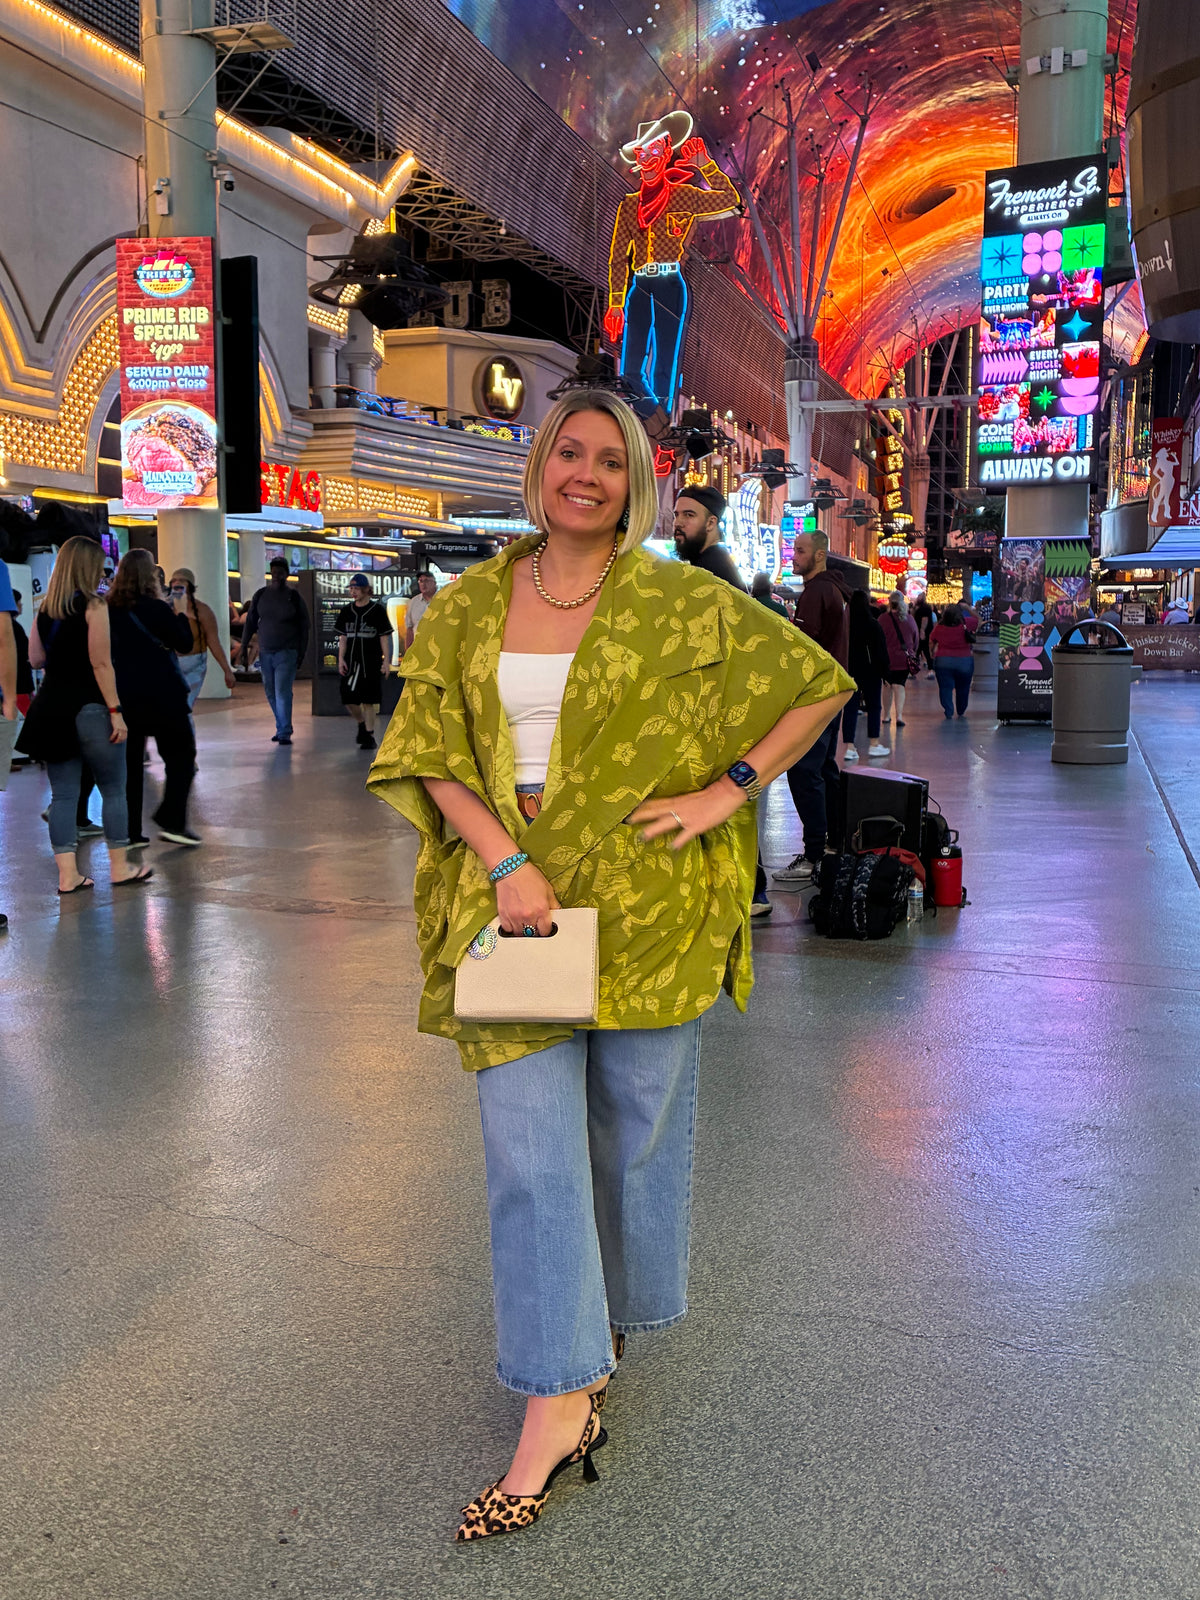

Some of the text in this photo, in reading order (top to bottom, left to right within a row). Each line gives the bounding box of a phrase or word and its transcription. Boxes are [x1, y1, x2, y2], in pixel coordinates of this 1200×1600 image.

[988, 166, 1102, 210] Fremont St.
[1004, 197, 1084, 216] EXPERIENCE
[1027, 213, 1051, 222] ALWAYS
[136, 270, 193, 279] TRIPLE 7
[984, 283, 1030, 300] PARTY
[123, 307, 209, 324] PRIME RIB
[984, 304, 1001, 314] EVER
[133, 324, 200, 341] SPECIAL
[1029, 349, 1062, 360] EVERY.
[125, 365, 209, 378] SERVED DAILY
[1029, 360, 1062, 370] SINGLE.
[1029, 369, 1062, 380] NIGHT.
[128, 379, 170, 391] 4:00pm
[176, 378, 208, 389] Close
[491, 363, 523, 409] LV
[979, 424, 1013, 436] COME
[1153, 428, 1182, 440] Whiskey
[988, 435, 1001, 443] YOU
[979, 442, 993, 452] GO
[981, 455, 1091, 481] ALWAYS ON
[438, 544, 468, 552] Fragrance
[879, 545, 910, 558] HOTEL
[373, 575, 413, 595] HOUR
[1168, 634, 1199, 653] Licker
[1143, 647, 1185, 657] Down Bar
[1018, 673, 1053, 686] Fremont
